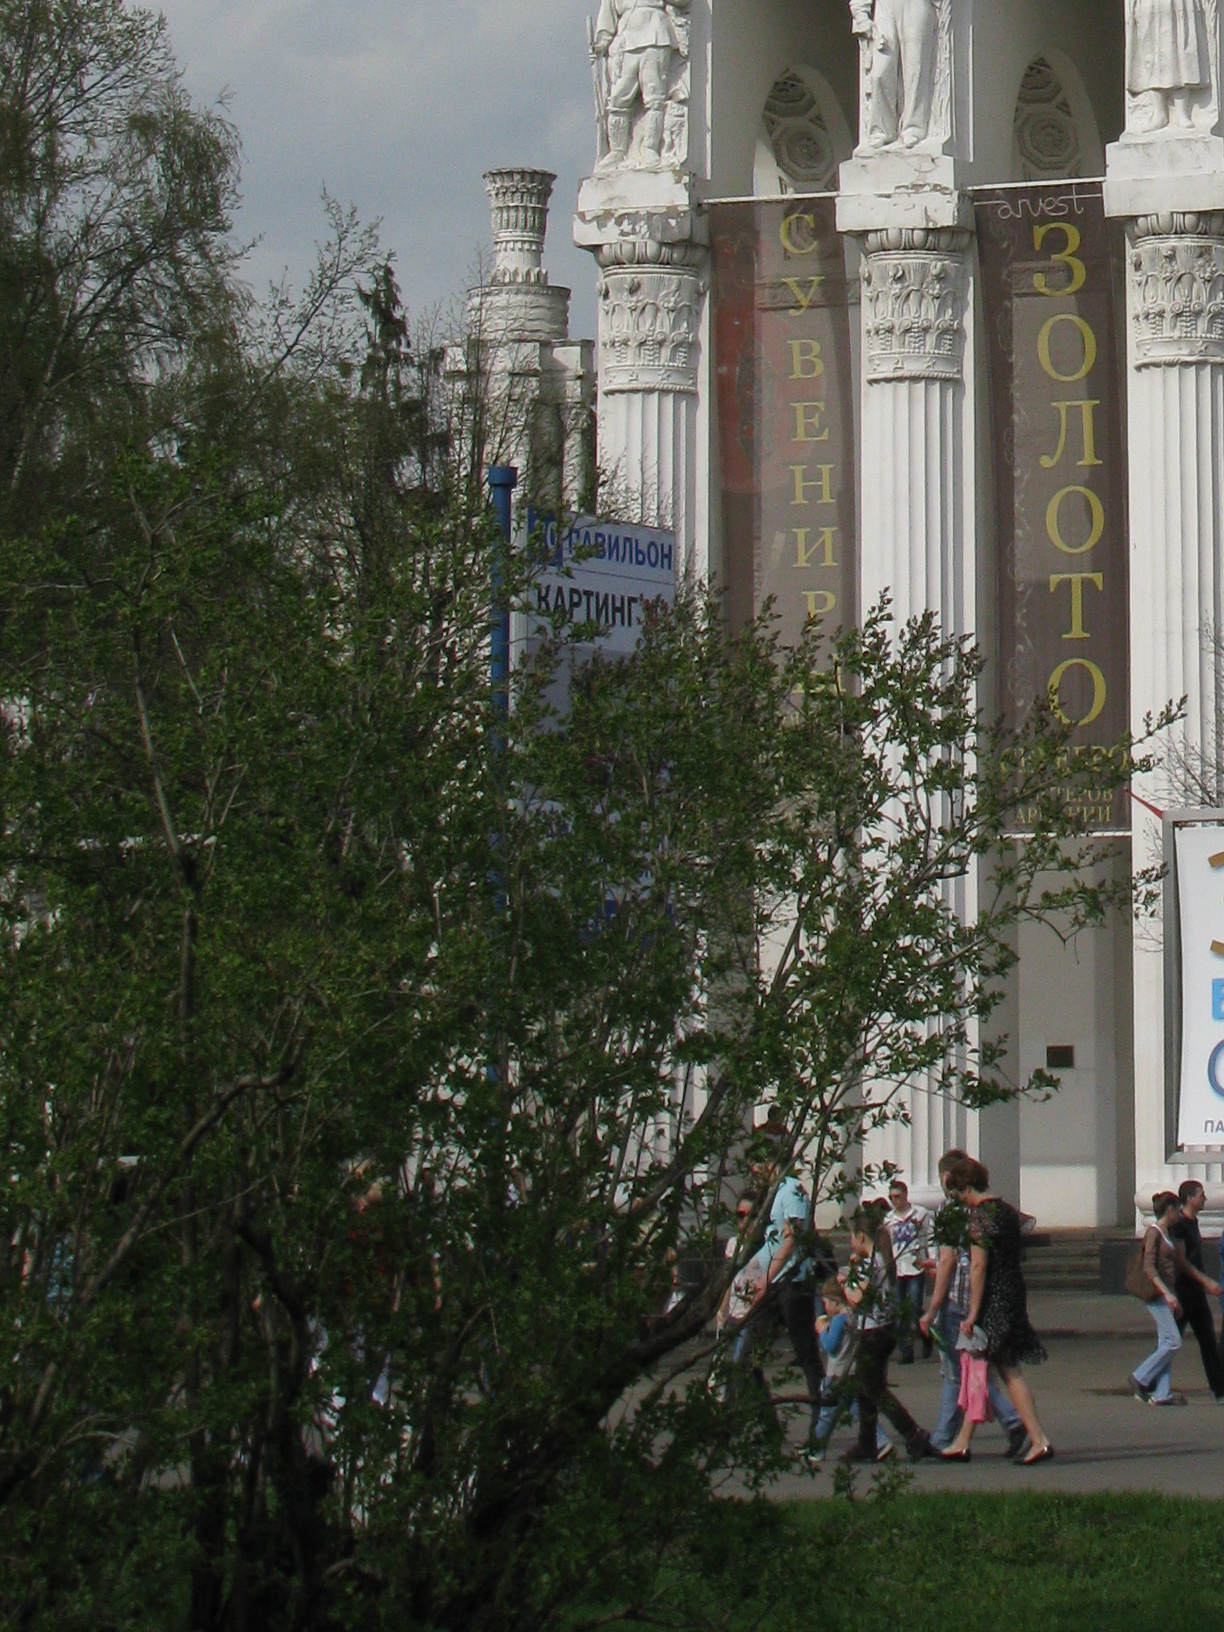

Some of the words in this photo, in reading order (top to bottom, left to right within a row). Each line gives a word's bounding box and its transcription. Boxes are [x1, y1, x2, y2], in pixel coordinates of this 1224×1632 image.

[1032, 222, 1107, 728] ЗОЛОТО
[568, 528, 673, 571] ПАВИЛЬОН
[536, 584, 638, 627] КАРТИНГ
